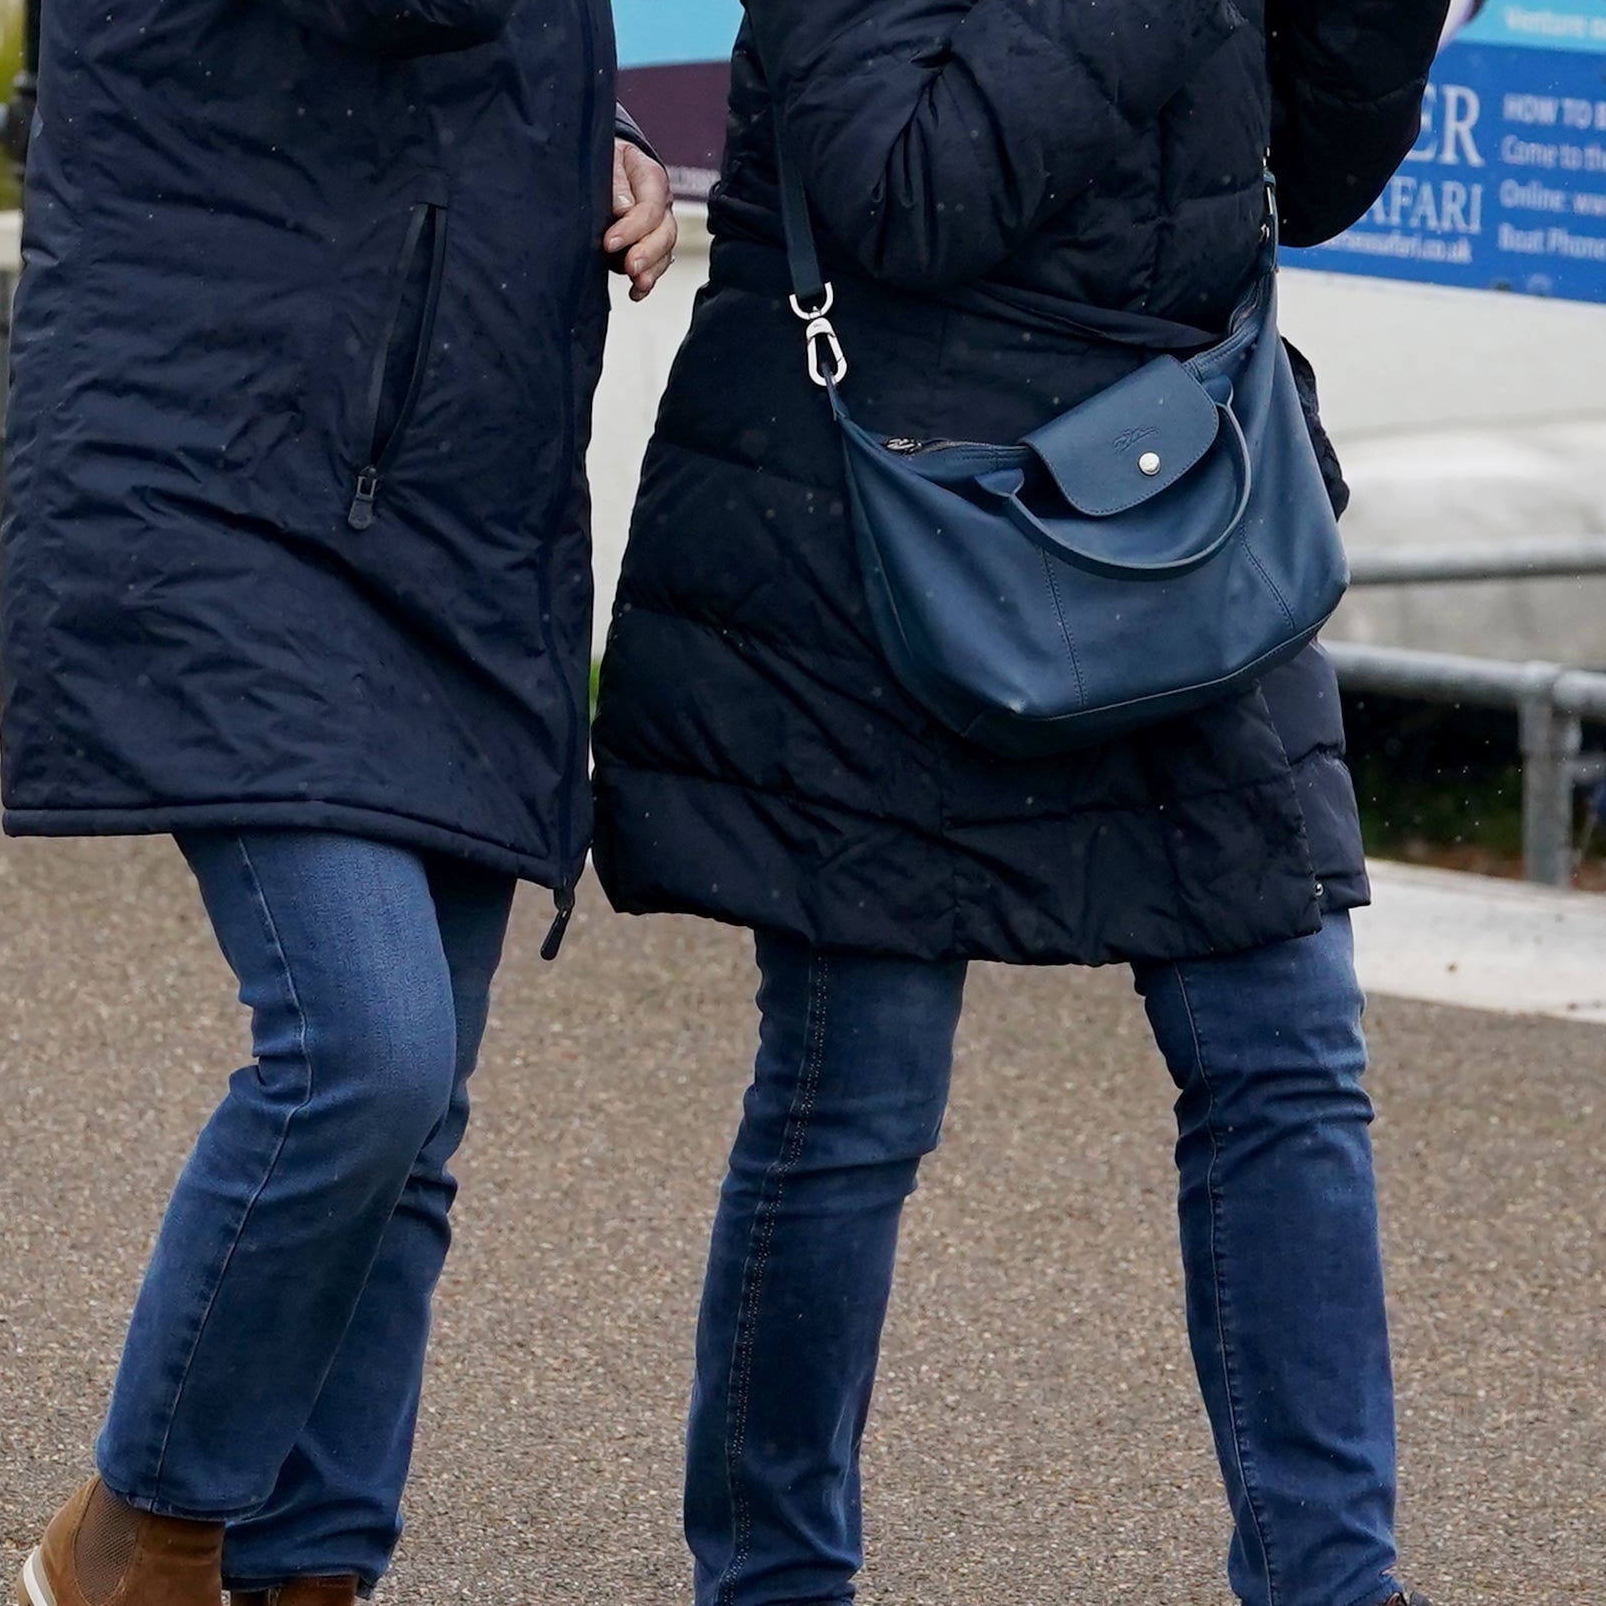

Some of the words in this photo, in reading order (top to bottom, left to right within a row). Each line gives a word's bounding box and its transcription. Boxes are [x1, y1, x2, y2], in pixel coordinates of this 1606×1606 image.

[1505, 6, 1585, 38] Venture
[1503, 93, 1559, 125] HOW
[1561, 97, 1592, 129] TO
[1501, 134, 1557, 168] Come
[1559, 143, 1583, 170] to
[1498, 222, 1544, 254] Boat
